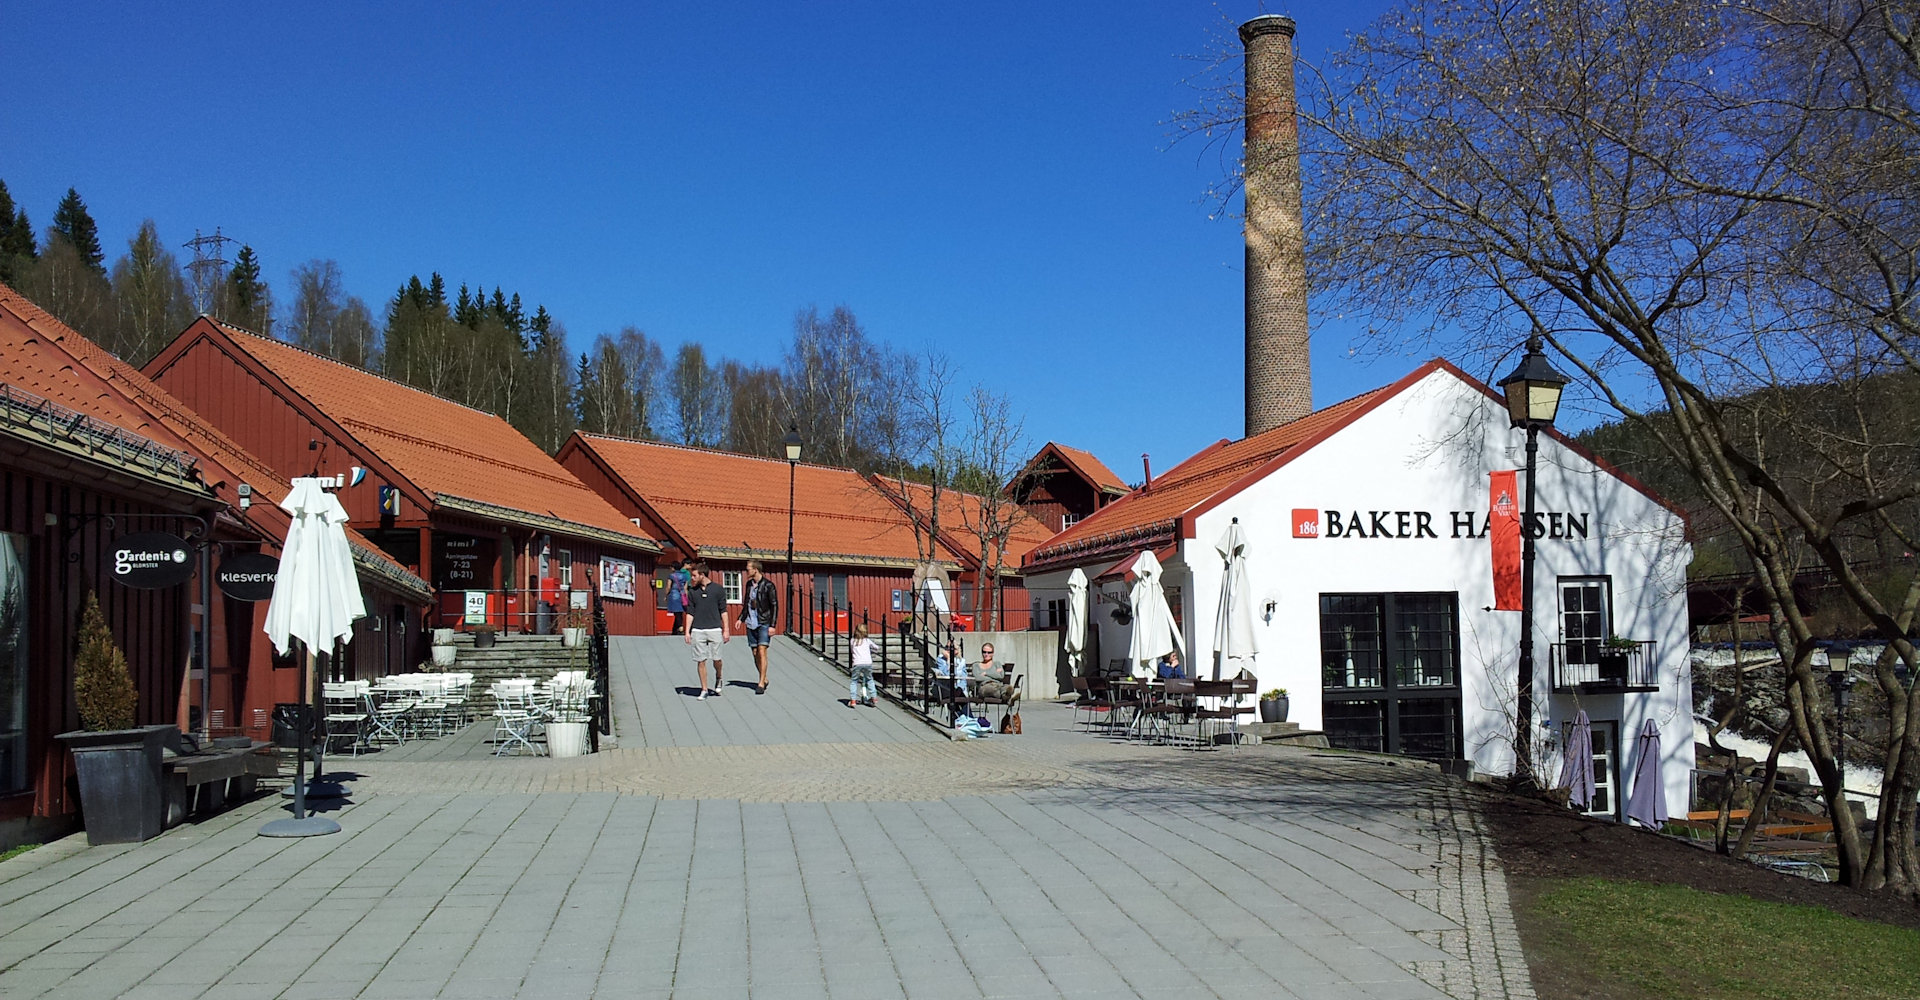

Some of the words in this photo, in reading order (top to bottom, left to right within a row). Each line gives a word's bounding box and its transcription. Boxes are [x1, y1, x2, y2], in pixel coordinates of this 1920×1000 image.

[1299, 521, 1319, 535] 1861
[1324, 510, 1439, 538] BAKER
[1450, 511, 1589, 540] HASEN
[115, 549, 171, 575] gardenia
[469, 597, 484, 605] 40
